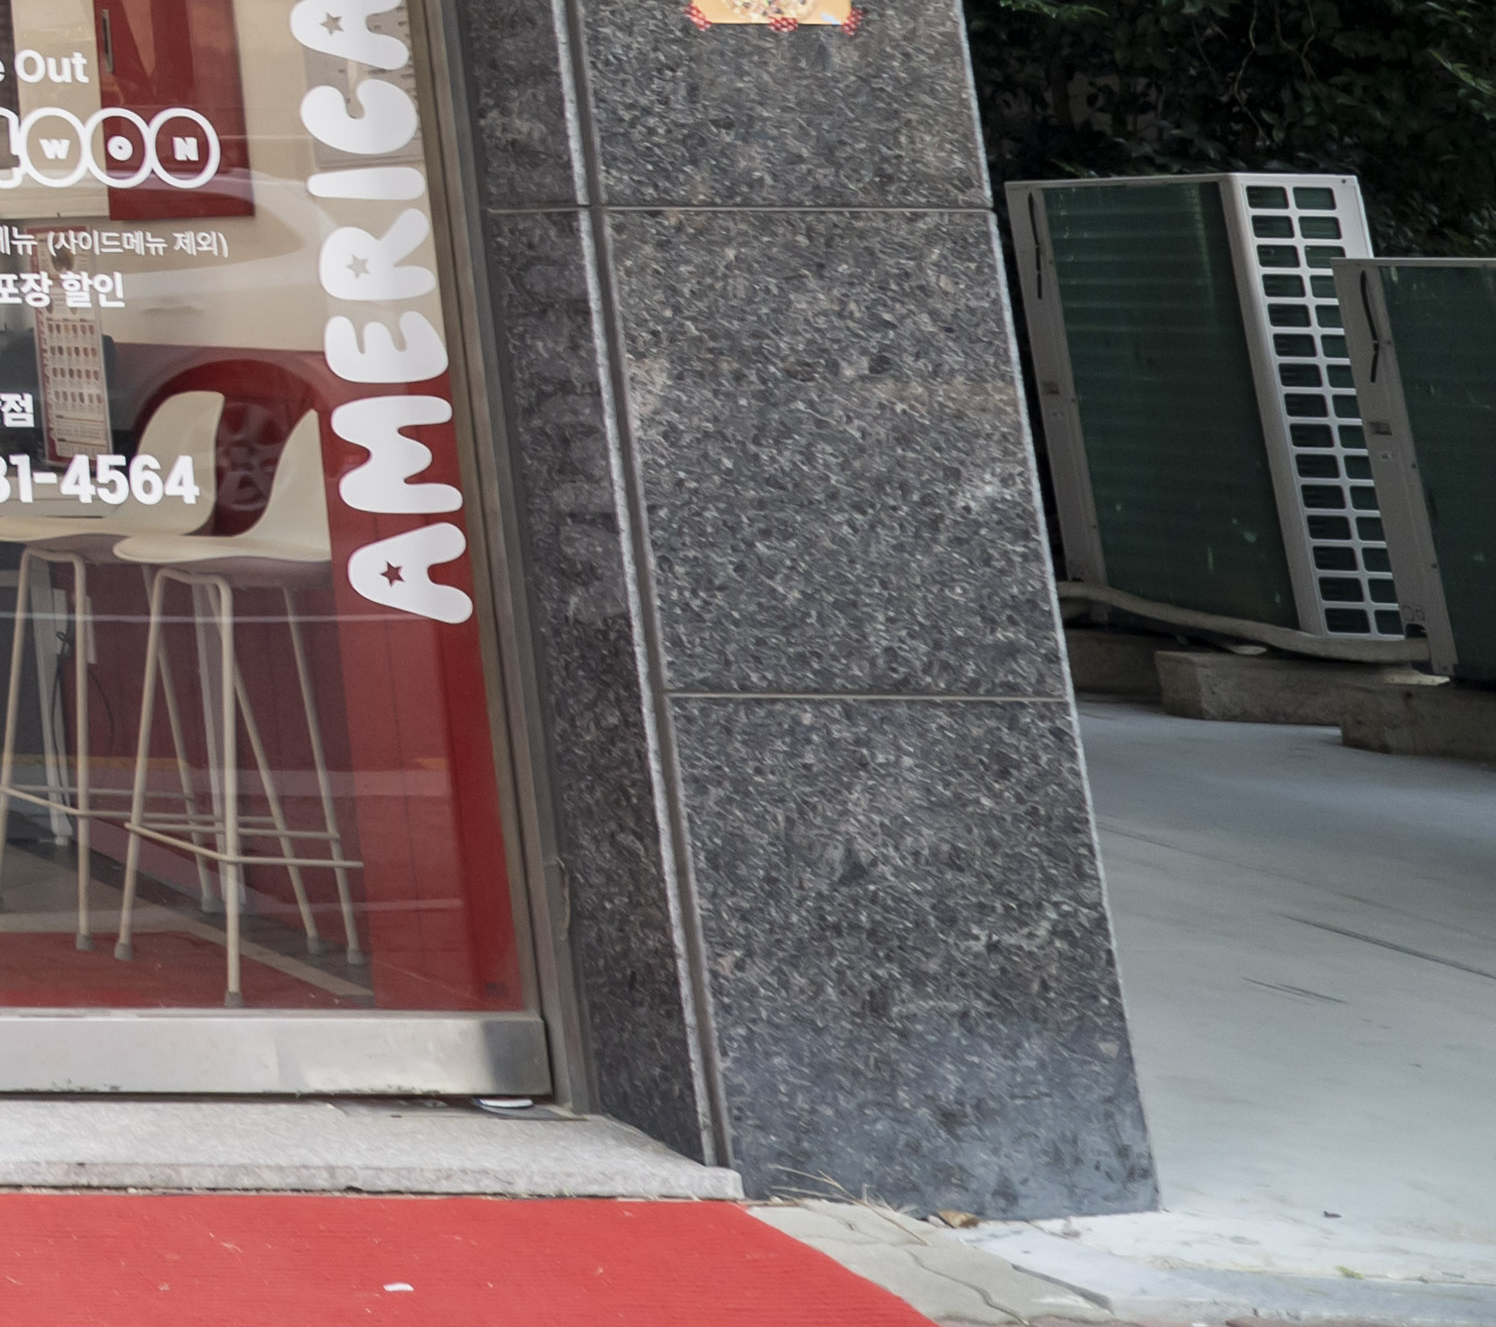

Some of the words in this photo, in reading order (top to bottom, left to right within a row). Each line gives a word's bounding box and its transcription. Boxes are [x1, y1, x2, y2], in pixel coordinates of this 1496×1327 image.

[15, 50, 89, 83] Out
[46, 230, 168, 258] (사이드메뉴
[173, 230, 229, 258] 제외)
[59, 271, 125, 308] 할인
